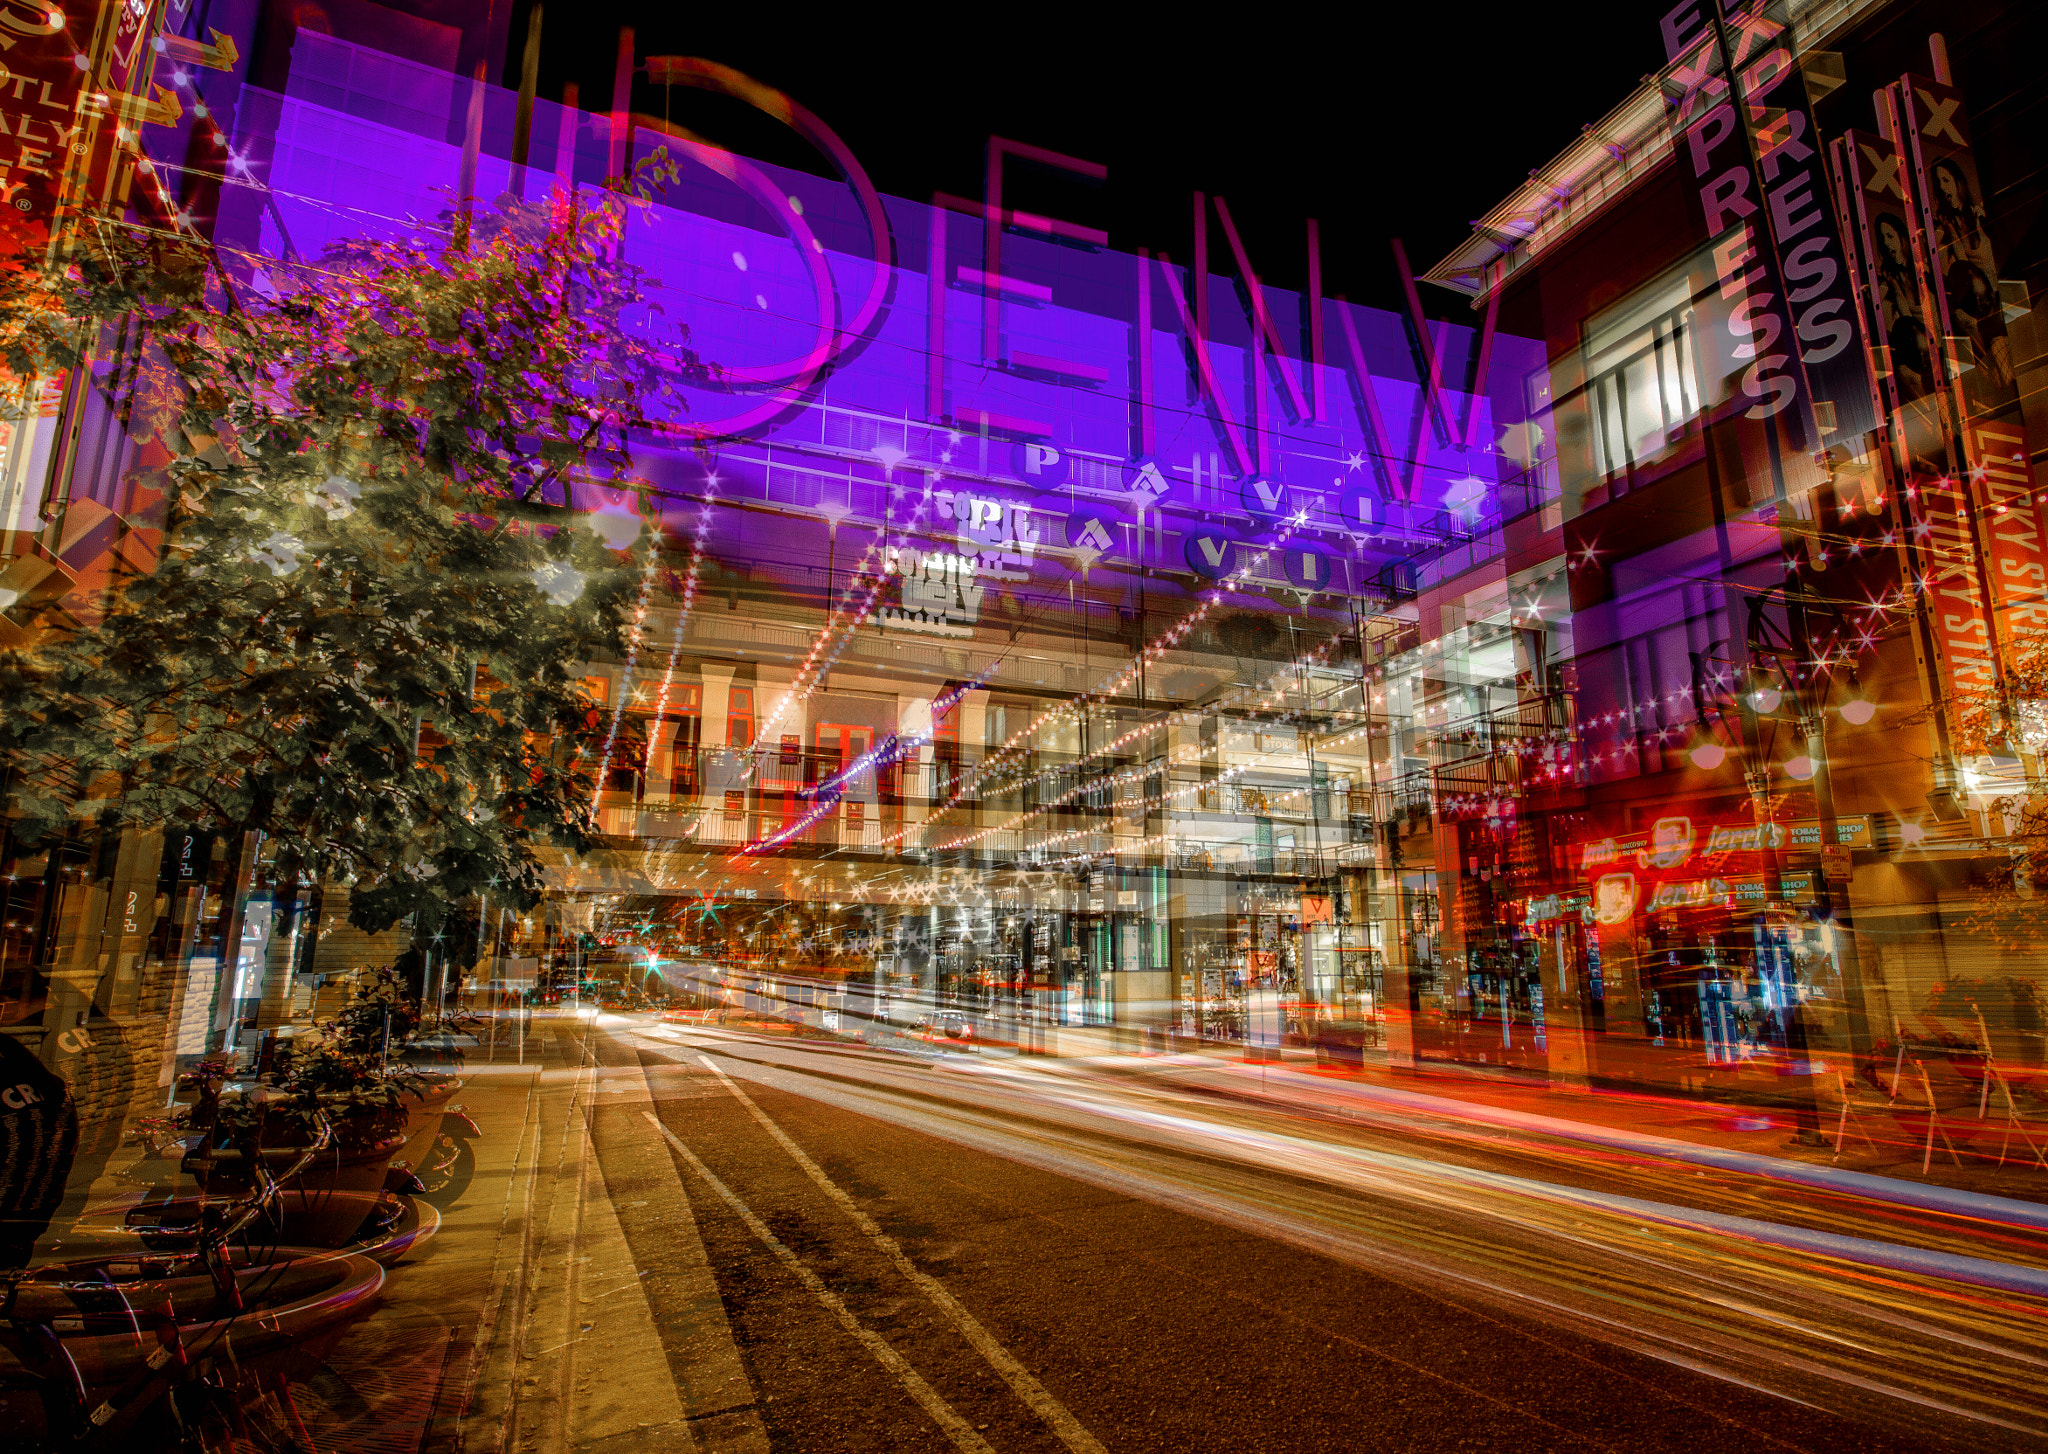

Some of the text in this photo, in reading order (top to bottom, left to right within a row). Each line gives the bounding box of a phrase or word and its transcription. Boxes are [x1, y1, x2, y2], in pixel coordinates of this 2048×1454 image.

[0, 70, 105, 120] TLE
[1716, 0, 1852, 365] XPRESS
[1263, 740, 1295, 750] STORE
[1790, 824, 1864, 836] TOBAC SHOP
[1800, 835, 1821, 844] FINE
[1734, 880, 1808, 892] TOBAC SHOP
[1744, 891, 1765, 900] FINE
